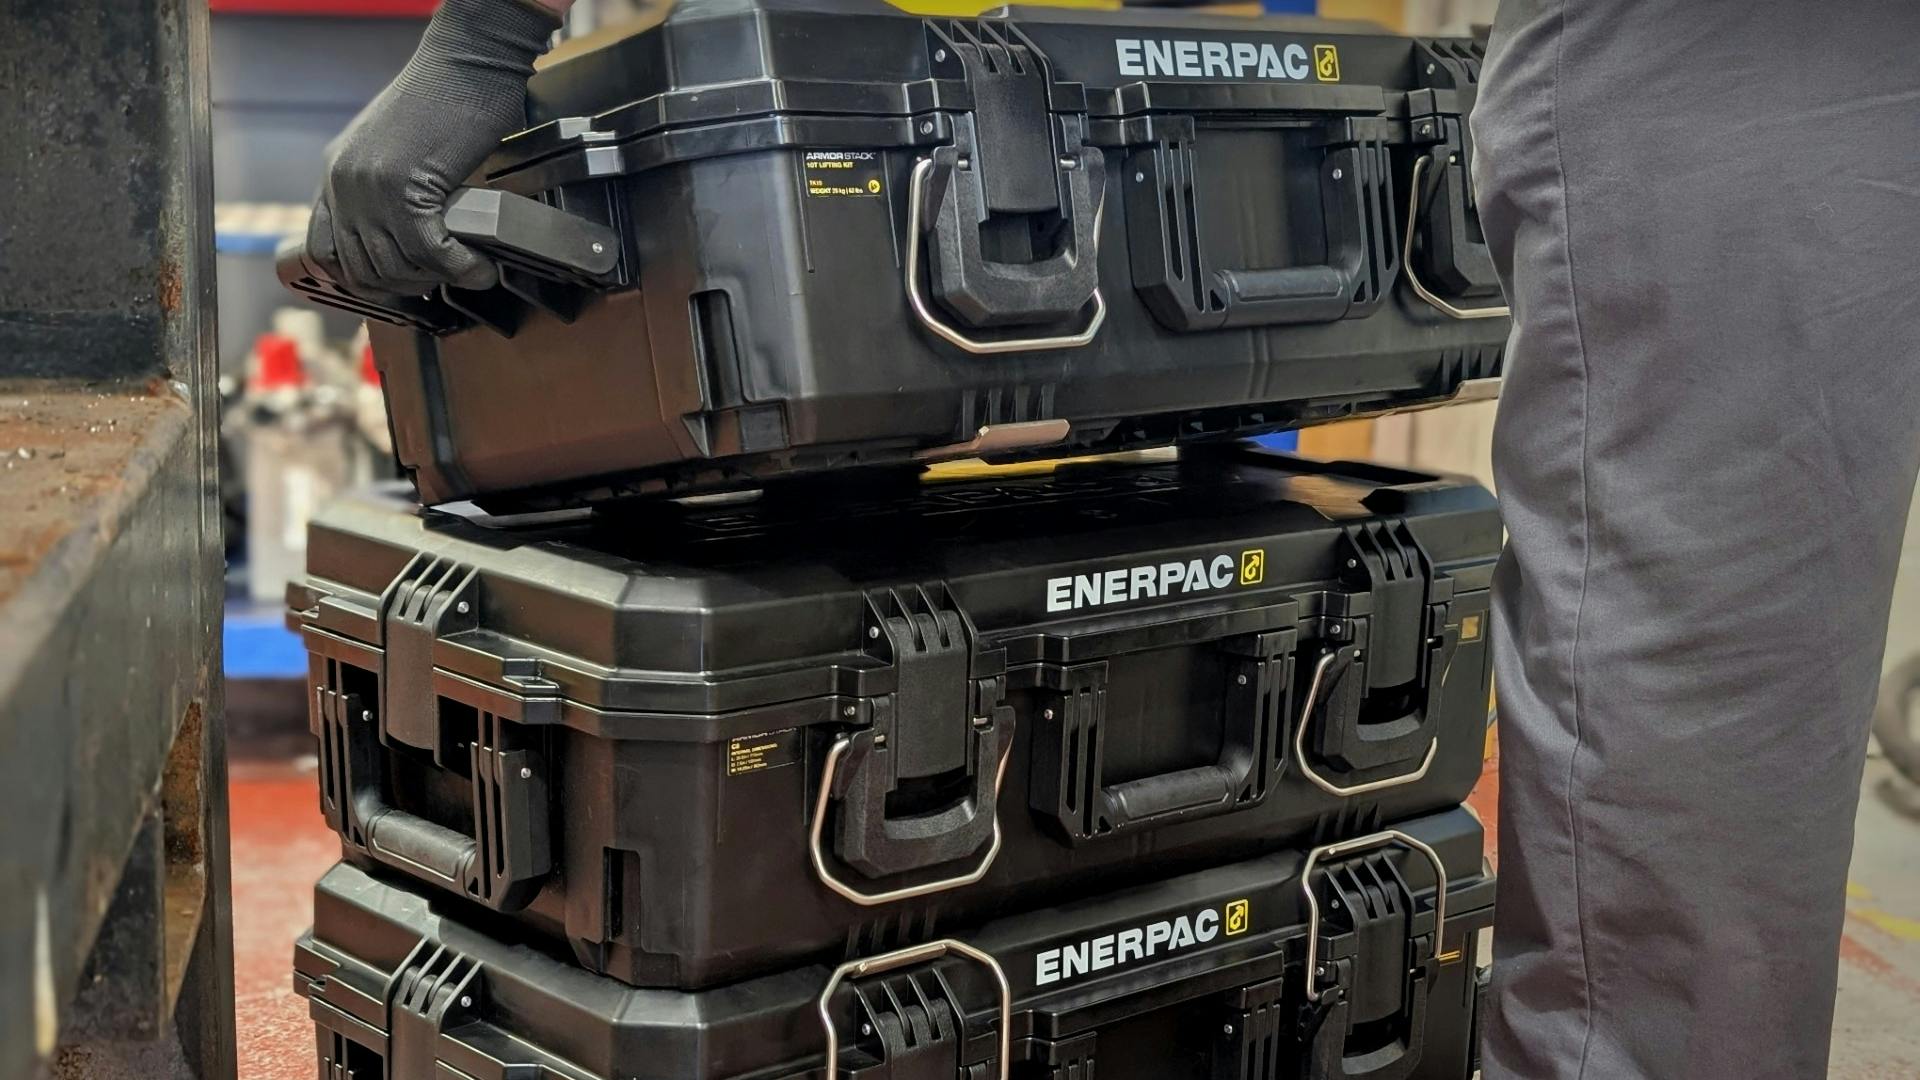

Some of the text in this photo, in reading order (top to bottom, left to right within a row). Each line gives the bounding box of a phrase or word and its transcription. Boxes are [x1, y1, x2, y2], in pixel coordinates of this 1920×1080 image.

[1115, 39, 1309, 80] ENERPAC
[1046, 554, 1235, 613] ENERPAC
[1036, 908, 1219, 986] ENERPAC
